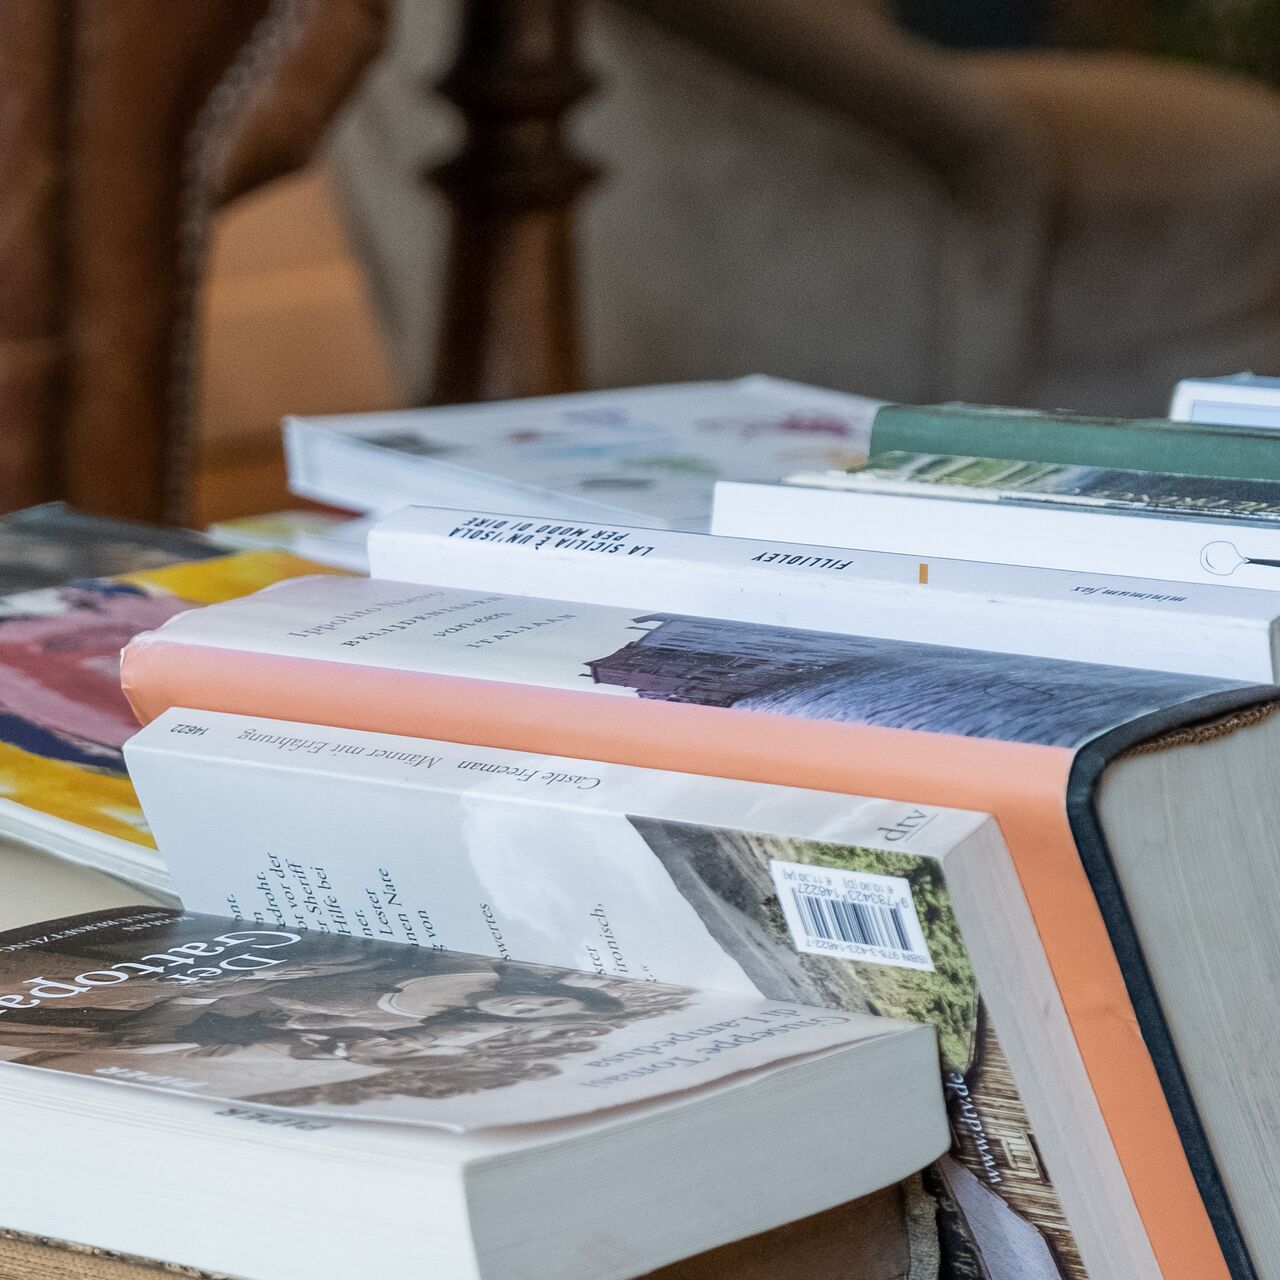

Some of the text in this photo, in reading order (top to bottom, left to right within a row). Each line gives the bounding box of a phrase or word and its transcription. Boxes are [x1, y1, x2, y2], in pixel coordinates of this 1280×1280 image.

[448, 527, 655, 557] LA SICILIA È UN'ISOLA
[462, 517, 631, 541] PER MODO DI DIRE
[751, 551, 854, 570] FILLIOLEY
[1070, 585, 1188, 603] minimum fax
[288, 605, 382, 638] Ippolito
[341, 595, 505, 648] BELIJDENISSEN
[433, 610, 513, 640] van een
[465, 612, 578, 649] ITALIAAN
[170, 723, 601, 790] Castle Freeman Männer mit Erfahrung 14622
[877, 809, 928, 842] dtv
[267, 852, 286, 879] der
[281, 883, 298, 909] vor
[285, 859, 322, 916] Sheriff
[310, 866, 352, 935] Hilfe bei
[378, 867, 403, 906] Nate
[798, 882, 910, 909] 9 783423 146227
[366, 888, 394, 936] Lester
[418, 910, 437, 938] von
[590, 903, 629, 974] ironisch,
[165, 953, 288, 986] Der
[902, 952, 929, 965] ISBN
[578, 1014, 851, 1089] Giuseppe Tomasi
[584, 1007, 802, 1069] di Lampedusa
[945, 1071, 1002, 1184] www.dtv.de
